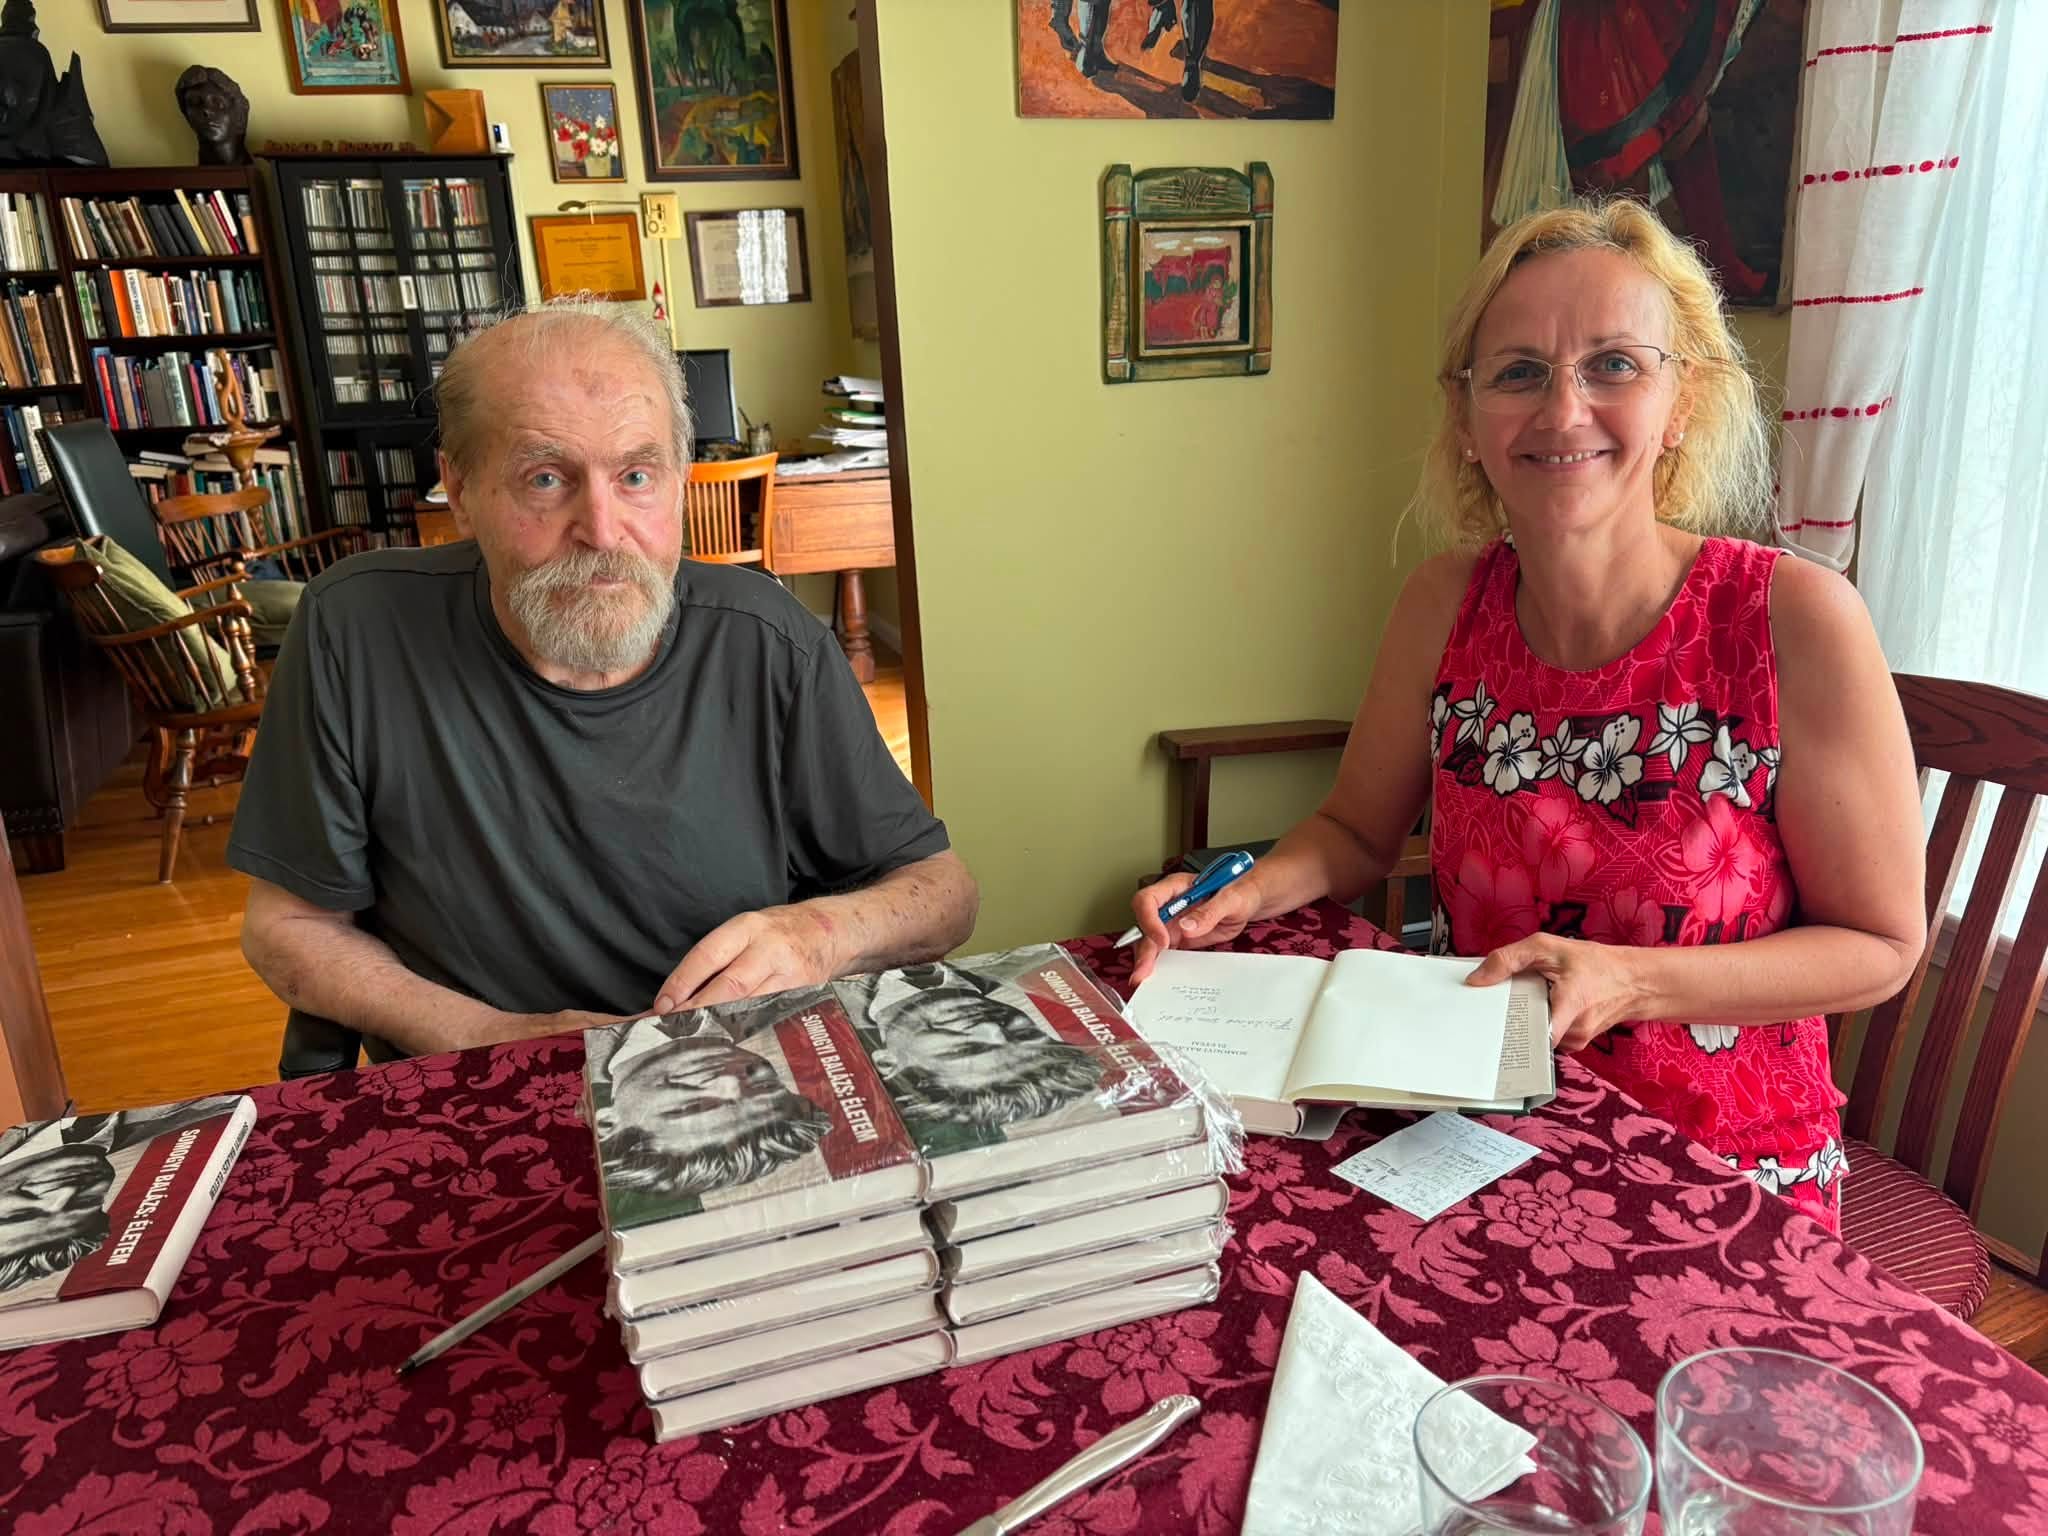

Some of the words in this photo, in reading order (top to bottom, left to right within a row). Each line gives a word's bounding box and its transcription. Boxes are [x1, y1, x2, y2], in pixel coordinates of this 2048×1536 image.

[1039, 970, 1084, 1008] SOMOGYI
[1071, 1006, 1116, 1045] BALÁZS:
[801, 1013, 838, 1056] SOMOGYI
[820, 1054, 855, 1098] BALÁZS:
[840, 1096, 879, 1143] ÉLETEM
[159, 1128, 201, 1173] SOMOGYI
[133, 1173, 176, 1219] BALÁZS:
[106, 1219, 154, 1266] ÉLETEM
